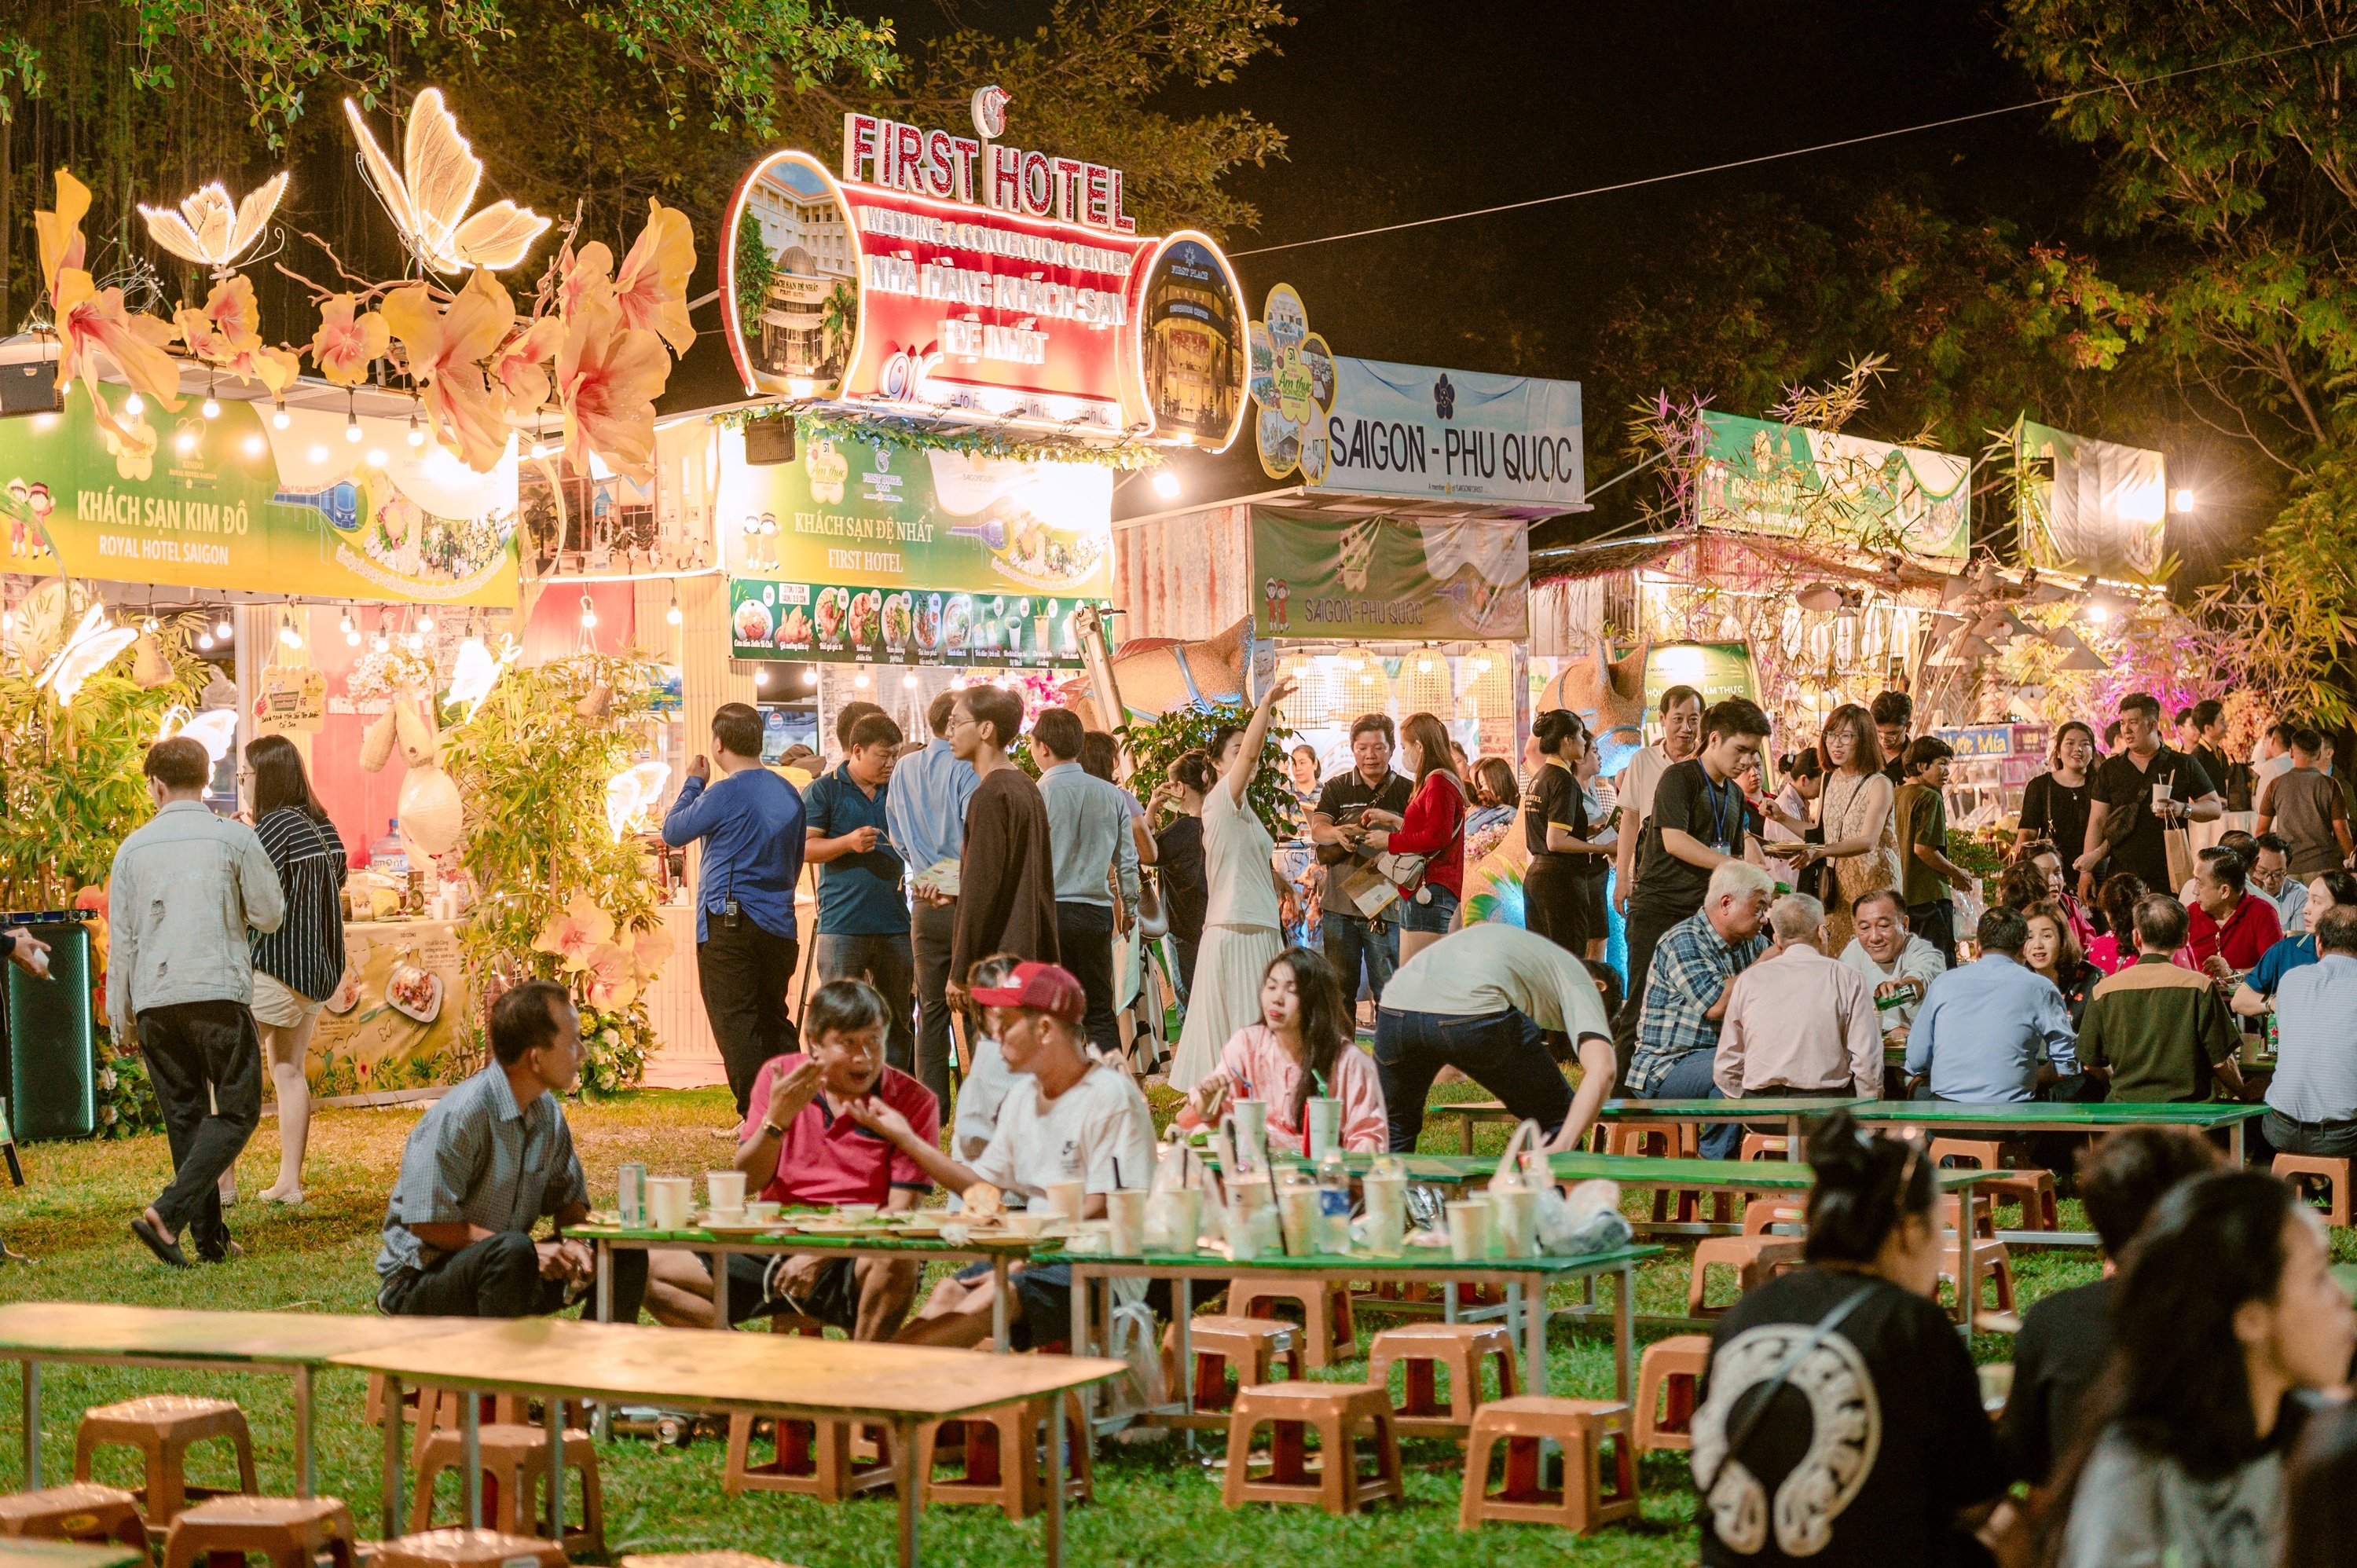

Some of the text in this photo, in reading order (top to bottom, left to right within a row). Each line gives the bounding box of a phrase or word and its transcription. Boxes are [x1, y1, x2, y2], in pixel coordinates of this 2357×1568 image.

[843, 112, 1135, 233] FIRST HOTEL
[859, 205, 1133, 276] WEDDING & CONVENTION CENTER
[1171, 265, 1208, 280] FIRST PLACE
[864, 250, 1127, 331] NHÀ HÀNG KHÁCH SẠN
[943, 313, 1049, 365] ĐỆ NHẤT
[960, 391, 1039, 416] to in
[1329, 416, 1426, 473] SAIGON
[1445, 428, 1494, 478] PHU
[1503, 433, 1571, 485] QUOC
[863, 472, 903, 486] FIRST HOTEL
[78, 485, 248, 536] KHÁCH SẠN KIM ĐÔ
[794, 509, 933, 545] KHÁCH SẠN ĐỆ NHẤT
[99, 535, 229, 566] ROYAL HOTEL SAIGON
[828, 548, 903, 573] FIRST HOTEL
[1305, 597, 1353, 623] SAIGON
[1362, 600, 1387, 624] PHU
[1389, 601, 1424, 625] QUOC
[1645, 683, 1744, 698] HỘI ẨM THỰC
[1978, 733, 2007, 753] Mía
